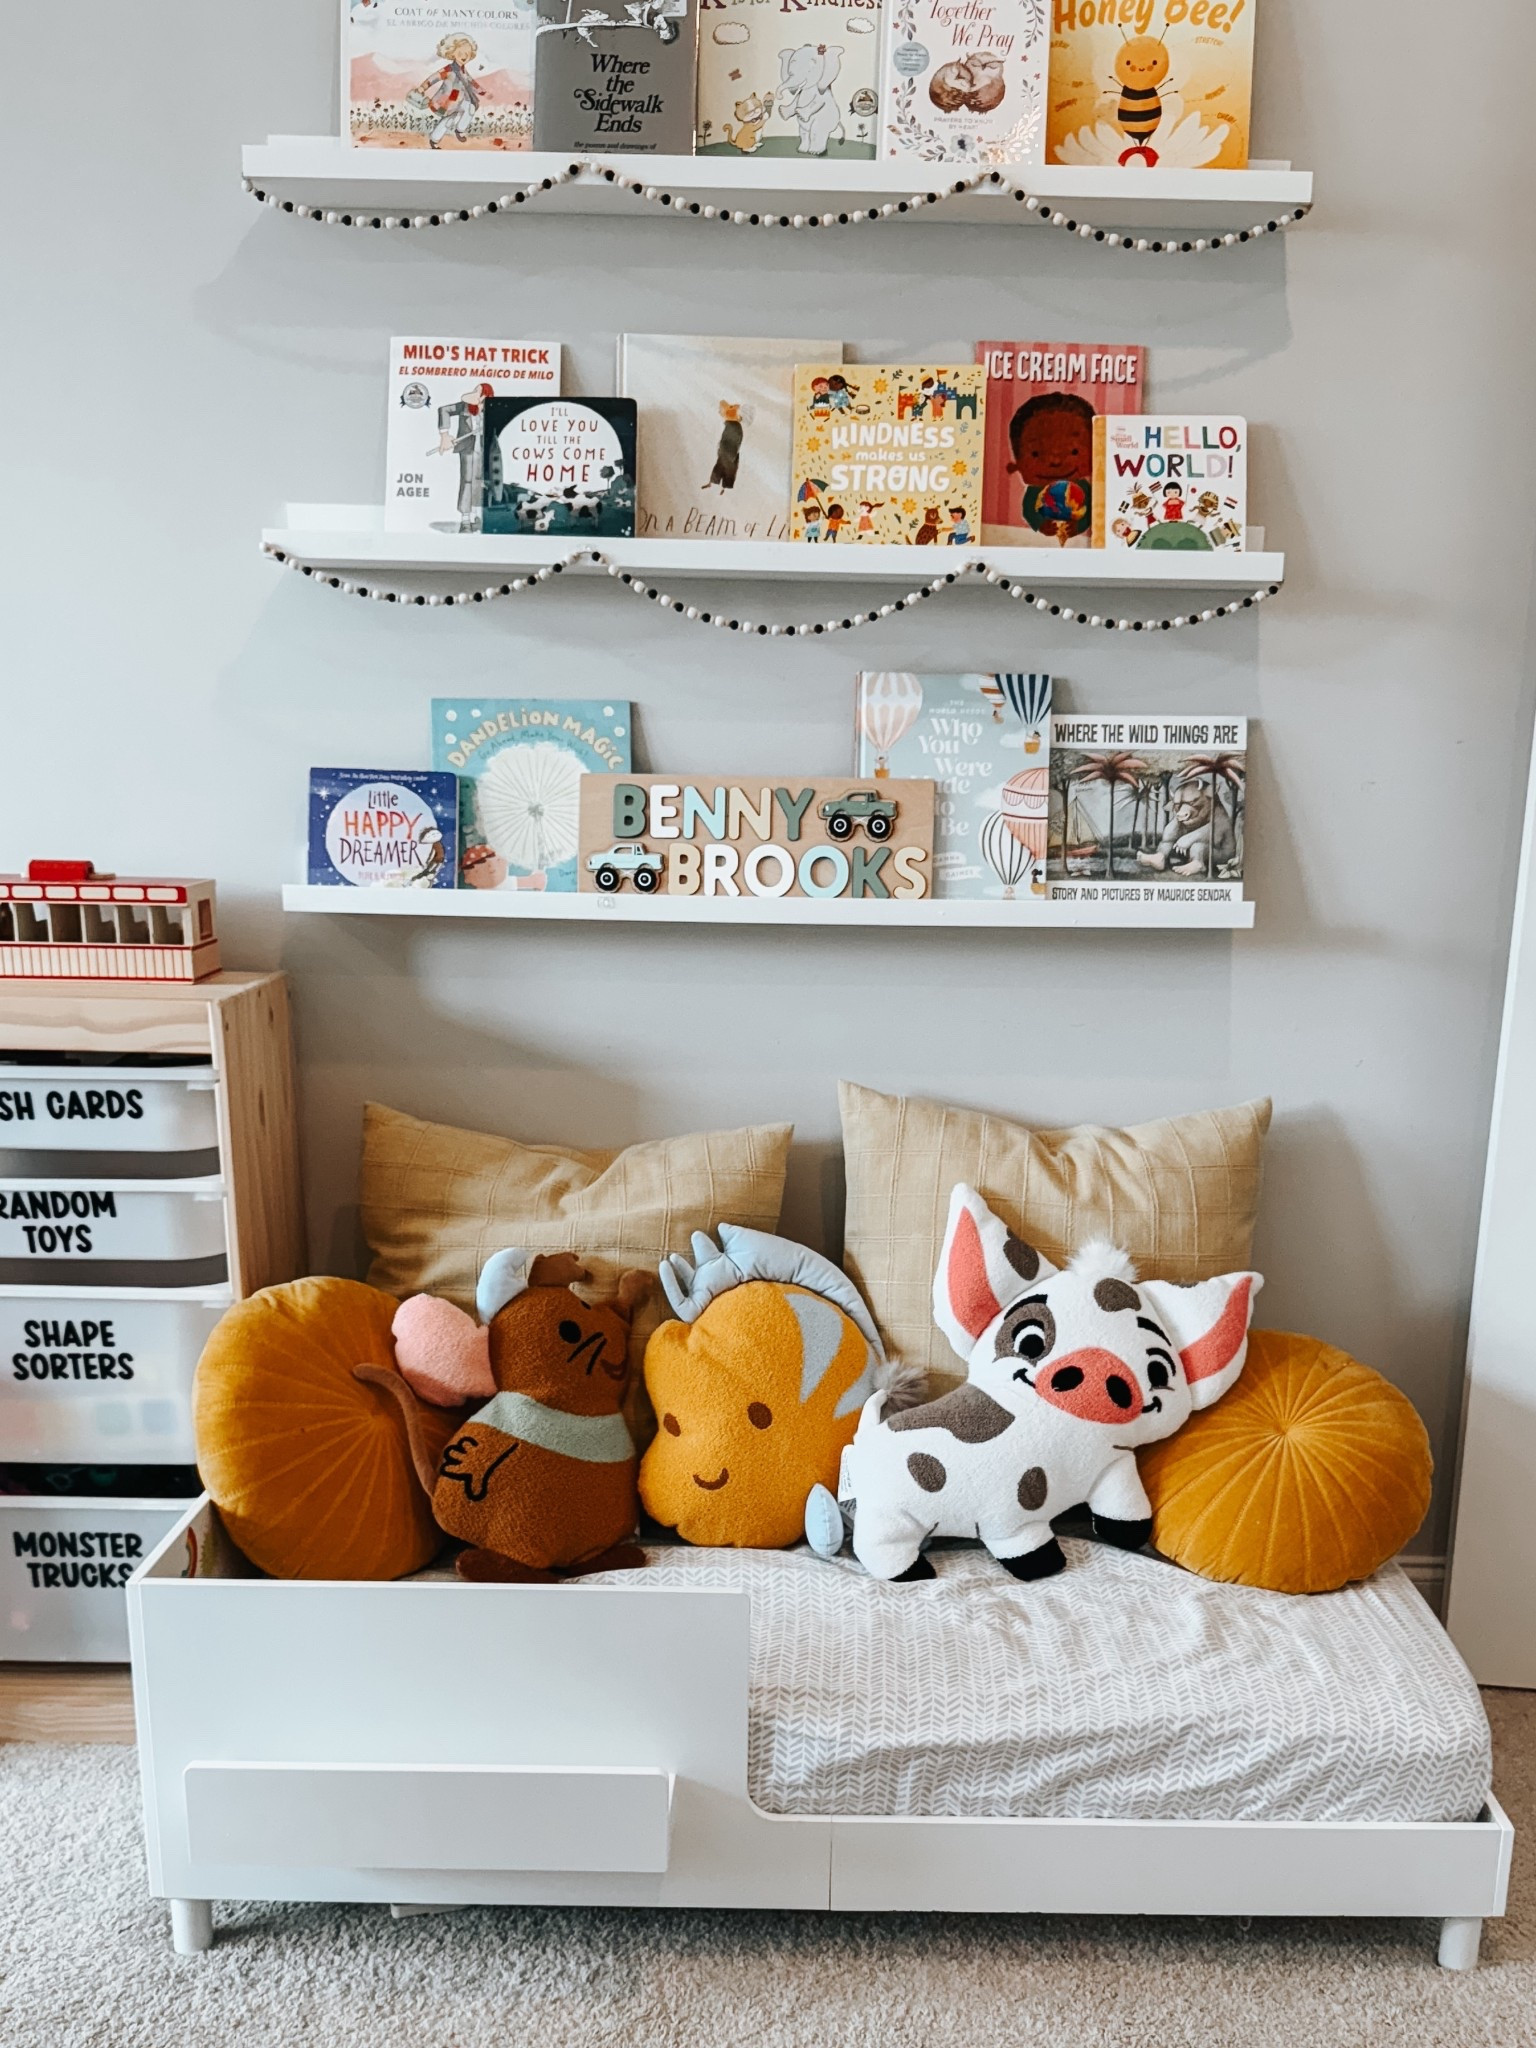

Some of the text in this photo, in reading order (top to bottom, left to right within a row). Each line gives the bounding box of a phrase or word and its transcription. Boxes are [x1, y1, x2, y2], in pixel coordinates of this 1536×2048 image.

[394, 8, 422, 16] COAT
[442, 8, 476, 18] MANY
[477, 10, 518, 20] COLORS
[930, 0, 996, 27] Together
[1053, 0, 1245, 34] Honey Bee!
[952, 22, 1014, 56] We Pray
[590, 54, 650, 74] Where
[606, 74, 634, 95] the
[574, 88, 664, 115] Sidewalk
[594, 112, 642, 132] Ends
[404, 345, 549, 364] MILO'S HAT TRICK
[399, 365, 554, 380] EL SOMBRERO MÁGICO DE MILO
[984, 351, 1137, 384] ICE CREAM FACE
[551, 407, 568, 417] I'LL
[521, 419, 598, 432] LOVE YOU
[831, 422, 955, 449] KINDNESS
[537, 435, 581, 445] TILL THE
[1145, 426, 1242, 452] HELLO,
[512, 447, 606, 460] COWS COME
[856, 448, 927, 462] makes us
[527, 464, 590, 482] HOME
[1114, 454, 1233, 478] WORLD!
[397, 473, 424, 484] JON
[830, 464, 950, 493] STRONG
[396, 487, 430, 498] AGEE
[448, 708, 625, 770] DANDELION MAGIC
[930, 718, 983, 745] Who
[1054, 723, 1239, 744] WHERE THE WILD THINGS ARE
[918, 735, 960, 754] You
[934, 757, 992, 777] Were
[368, 790, 399, 809] Little
[612, 783, 816, 842] BENNY
[344, 810, 423, 840] HAPPY
[941, 817, 970, 836] Be
[339, 838, 424, 868] DREAMER
[668, 843, 928, 900] BROOKS
[1052, 887, 1232, 901] STORY AND PICTURES BY MAURICE SENDAK
[46, 1089, 144, 1120] CARDS
[22, 1224, 93, 1253] TOYS
[24, 1320, 115, 1348] SHAPE
[13, 1353, 134, 1381] SORTERS
[13, 1531, 143, 1558] MONSTER
[27, 1562, 134, 1588] TRUCKS
